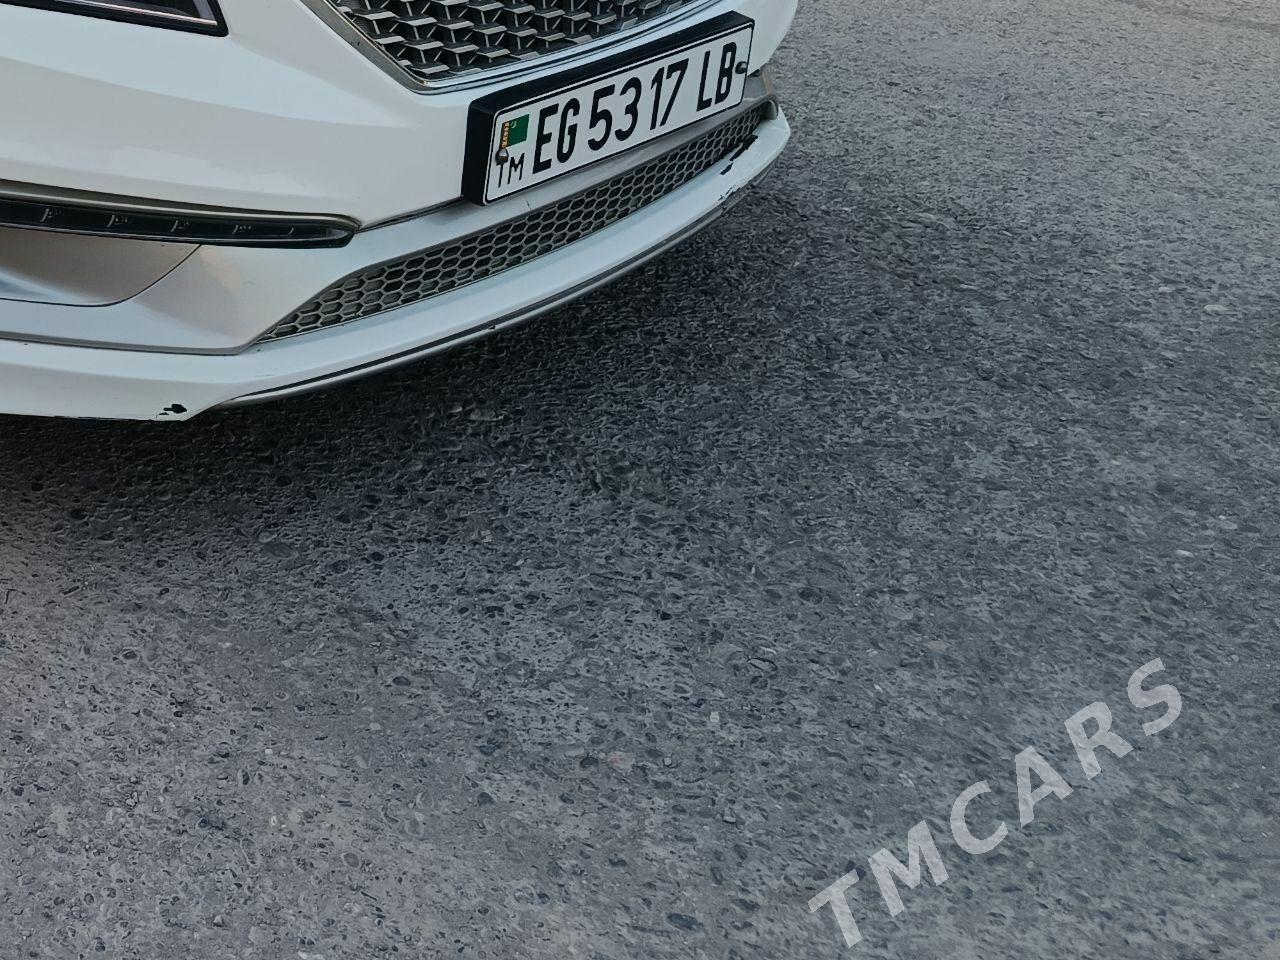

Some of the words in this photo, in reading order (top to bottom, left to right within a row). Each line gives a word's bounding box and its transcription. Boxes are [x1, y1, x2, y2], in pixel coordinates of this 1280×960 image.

[532, 97, 580, 174] EG
[587, 58, 689, 151] 5317
[696, 41, 737, 112] LB
